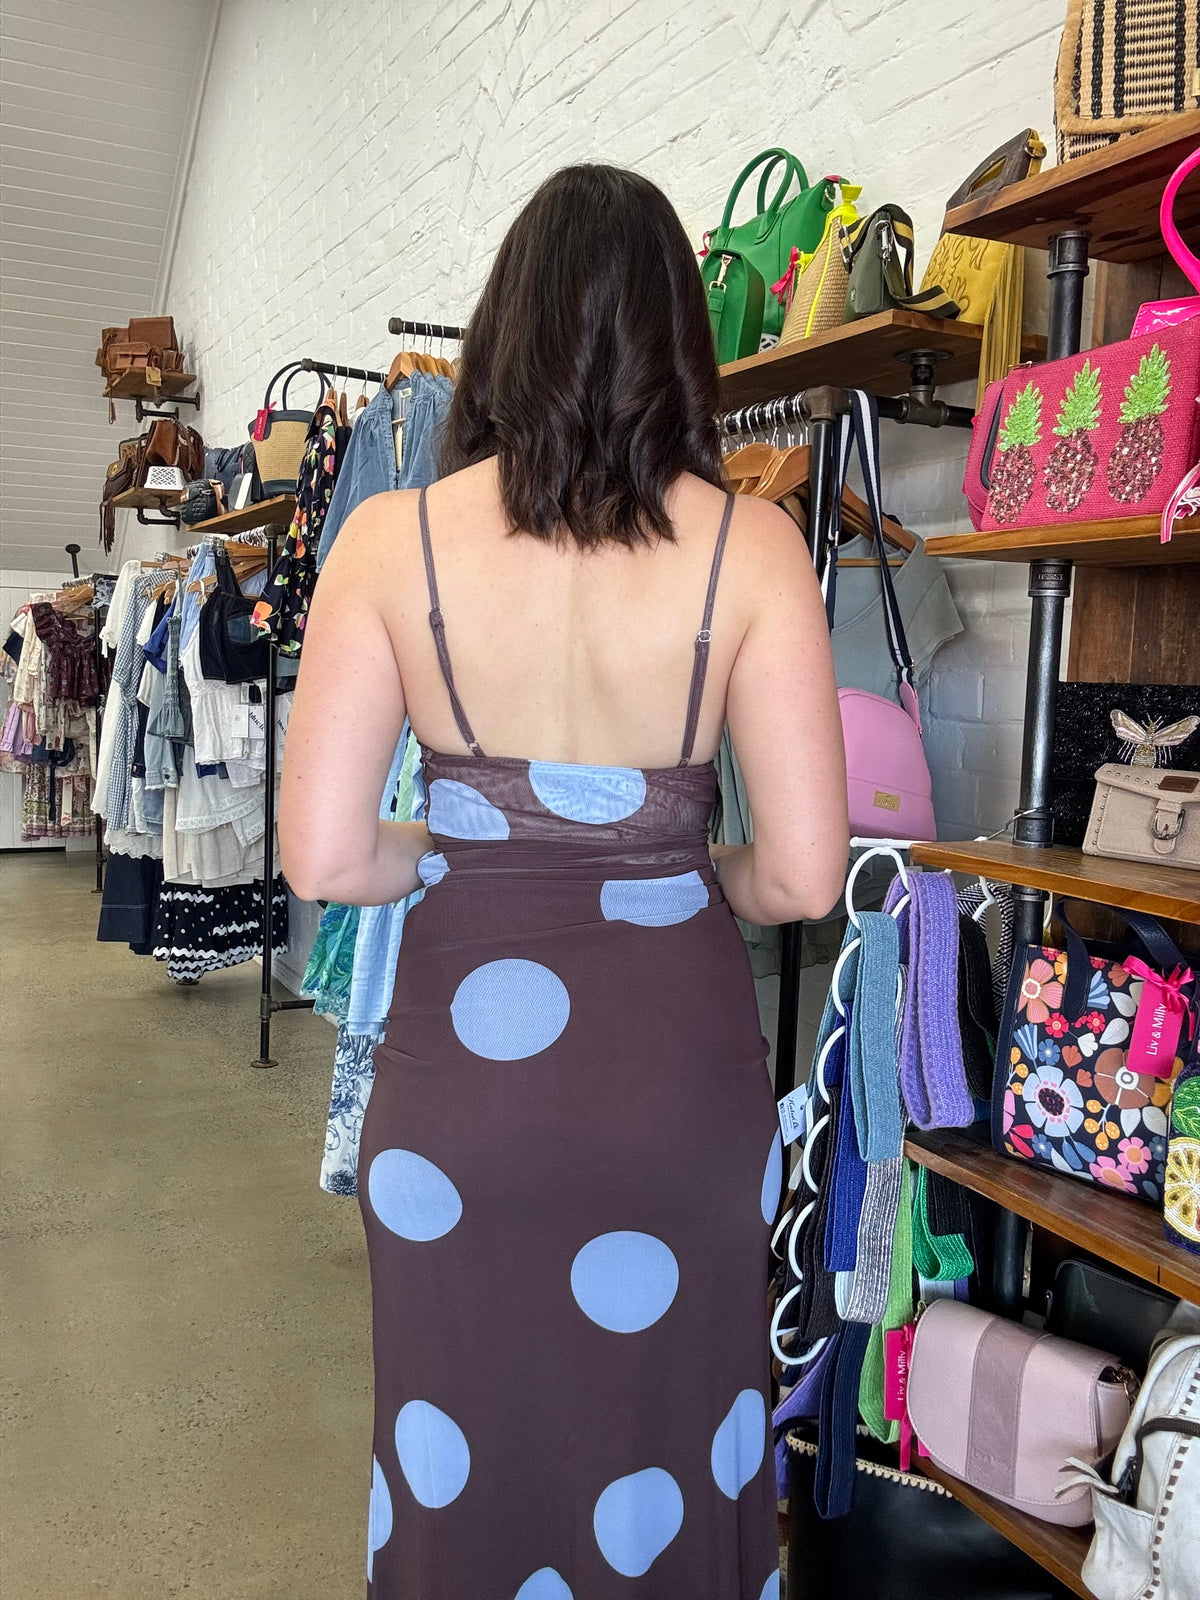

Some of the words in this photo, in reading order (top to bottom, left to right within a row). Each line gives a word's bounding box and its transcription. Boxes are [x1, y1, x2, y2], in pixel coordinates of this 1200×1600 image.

[1151, 1002, 1167, 1029] Milly
[1151, 1031, 1161, 1039] &
[1145, 1040, 1159, 1056] Liv
